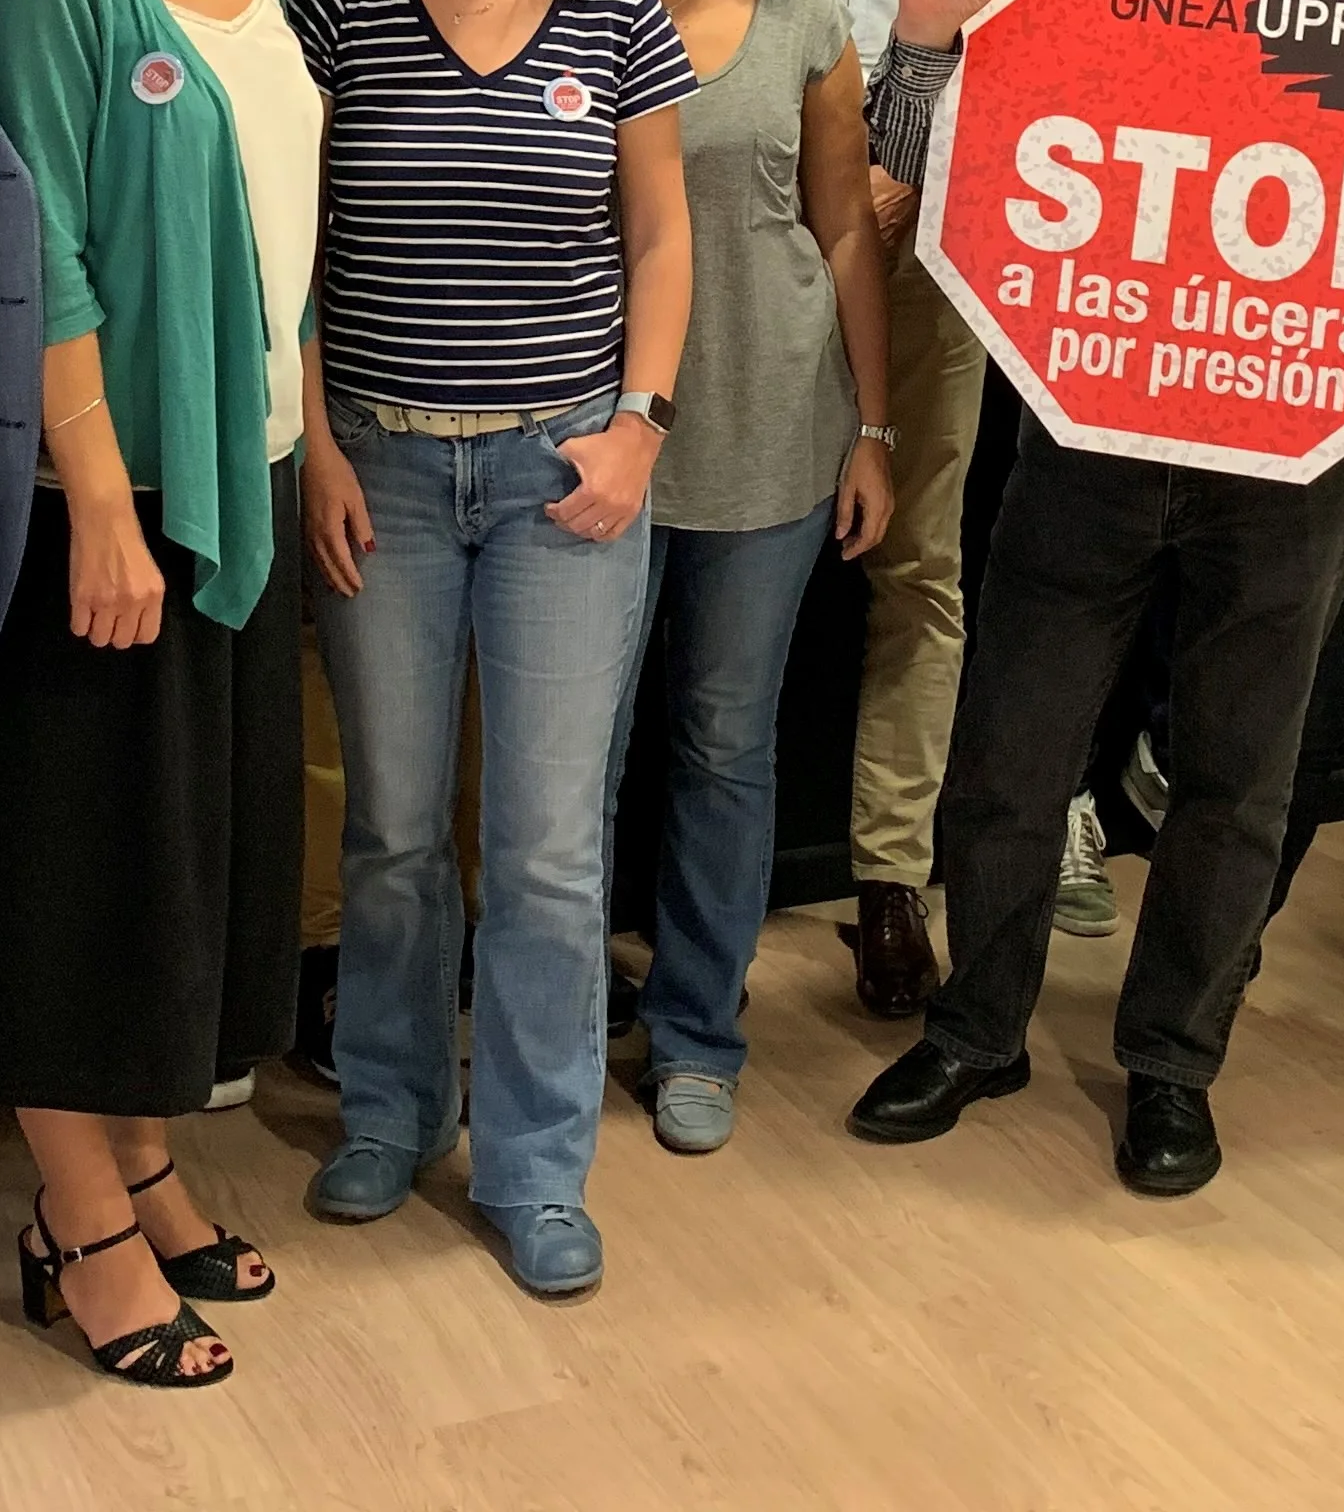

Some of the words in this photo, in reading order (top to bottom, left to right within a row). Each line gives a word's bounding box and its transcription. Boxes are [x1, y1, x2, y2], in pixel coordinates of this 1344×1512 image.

[997, 263, 1034, 308] a
[1056, 258, 1150, 323] las
[1046, 327, 1137, 382] por
